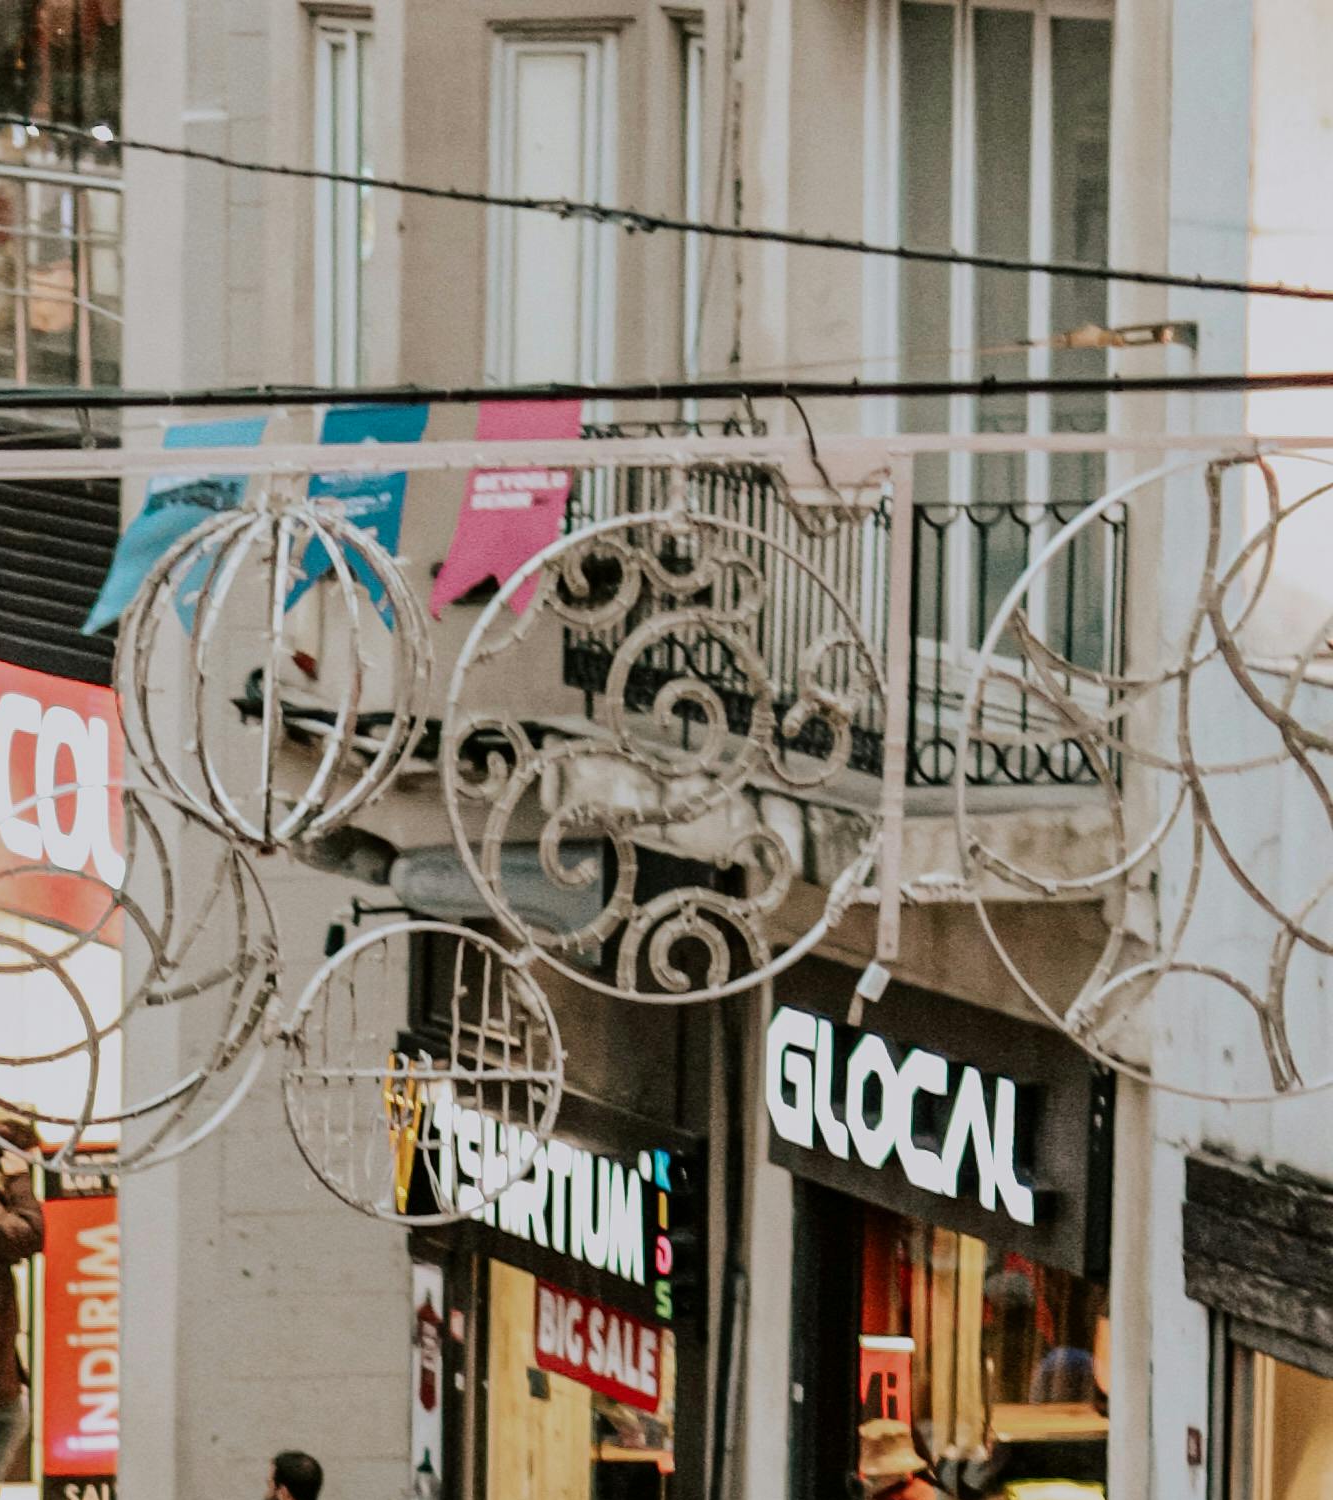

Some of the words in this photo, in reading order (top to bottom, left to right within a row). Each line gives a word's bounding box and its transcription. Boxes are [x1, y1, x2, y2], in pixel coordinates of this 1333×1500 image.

[766, 1006, 1034, 1226] GLOCAL
[538, 1287, 584, 1367] BIG
[587, 1306, 658, 1397] SALE
